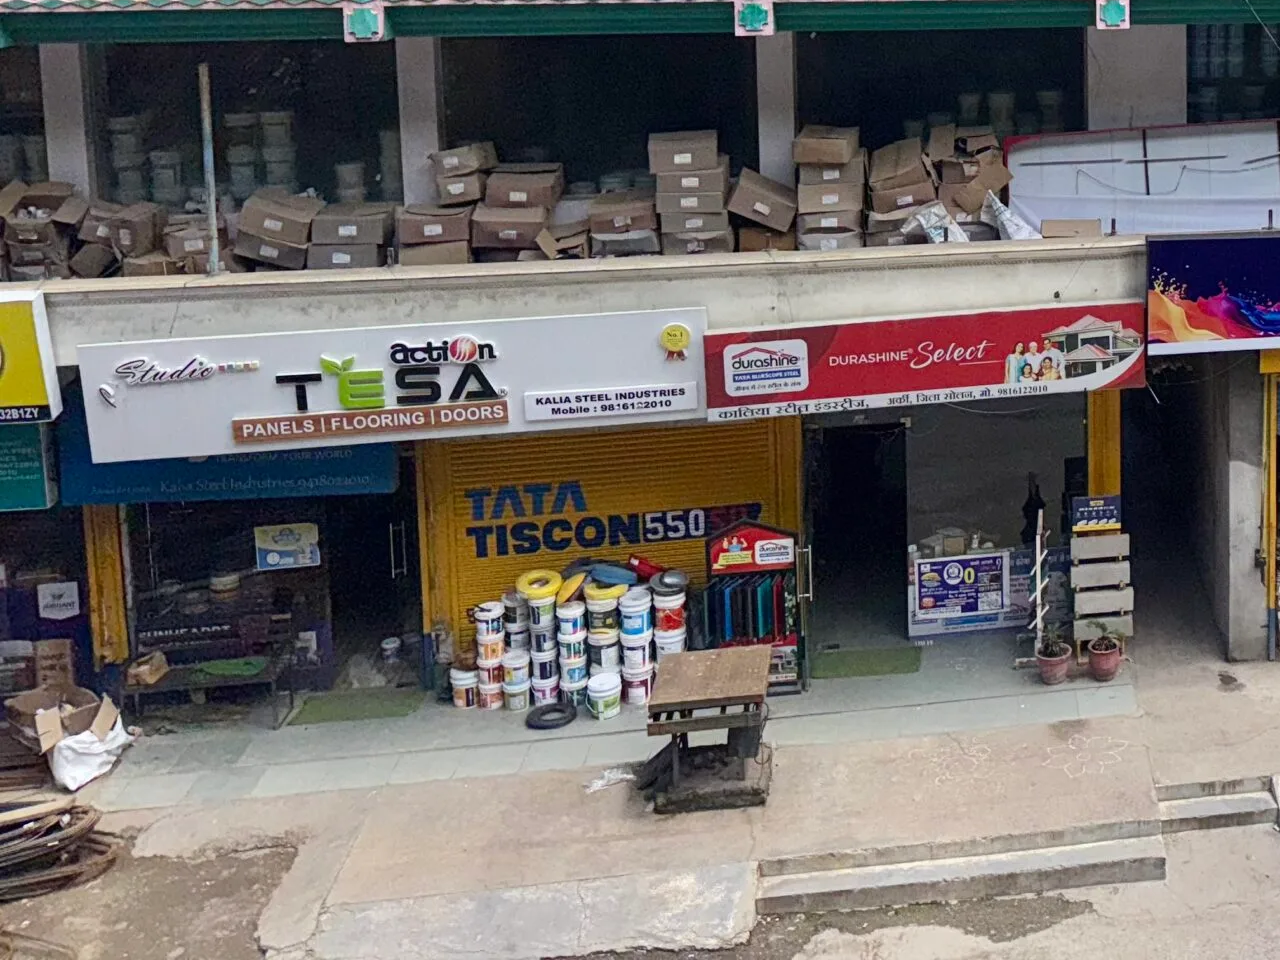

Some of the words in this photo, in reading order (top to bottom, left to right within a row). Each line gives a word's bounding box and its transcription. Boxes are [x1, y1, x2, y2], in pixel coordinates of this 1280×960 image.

[390, 335, 497, 364] action
[731, 354, 799, 370] durashine
[829, 351, 908, 367] DURASHINE
[909, 340, 997, 369] Select
[114, 354, 216, 385] Studio
[275, 358, 499, 411] TESA
[535, 393, 571, 406] KALIA
[574, 391, 613, 404] STEEL
[615, 387, 686, 401] INDUSTRIES
[551, 405, 590, 415] Mobile
[718, 407, 771, 420] कालिया
[776, 402, 809, 416] स्टील
[916, 393, 940, 403] जिला
[997, 385, 1048, 396] 9816122010
[242, 419, 314, 438] PANELS
[331, 411, 425, 431] FLOORING
[440, 405, 504, 423] DOORS
[464, 480, 587, 521] TATA
[466, 512, 640, 558] TISCON
[643, 509, 706, 542] 550
